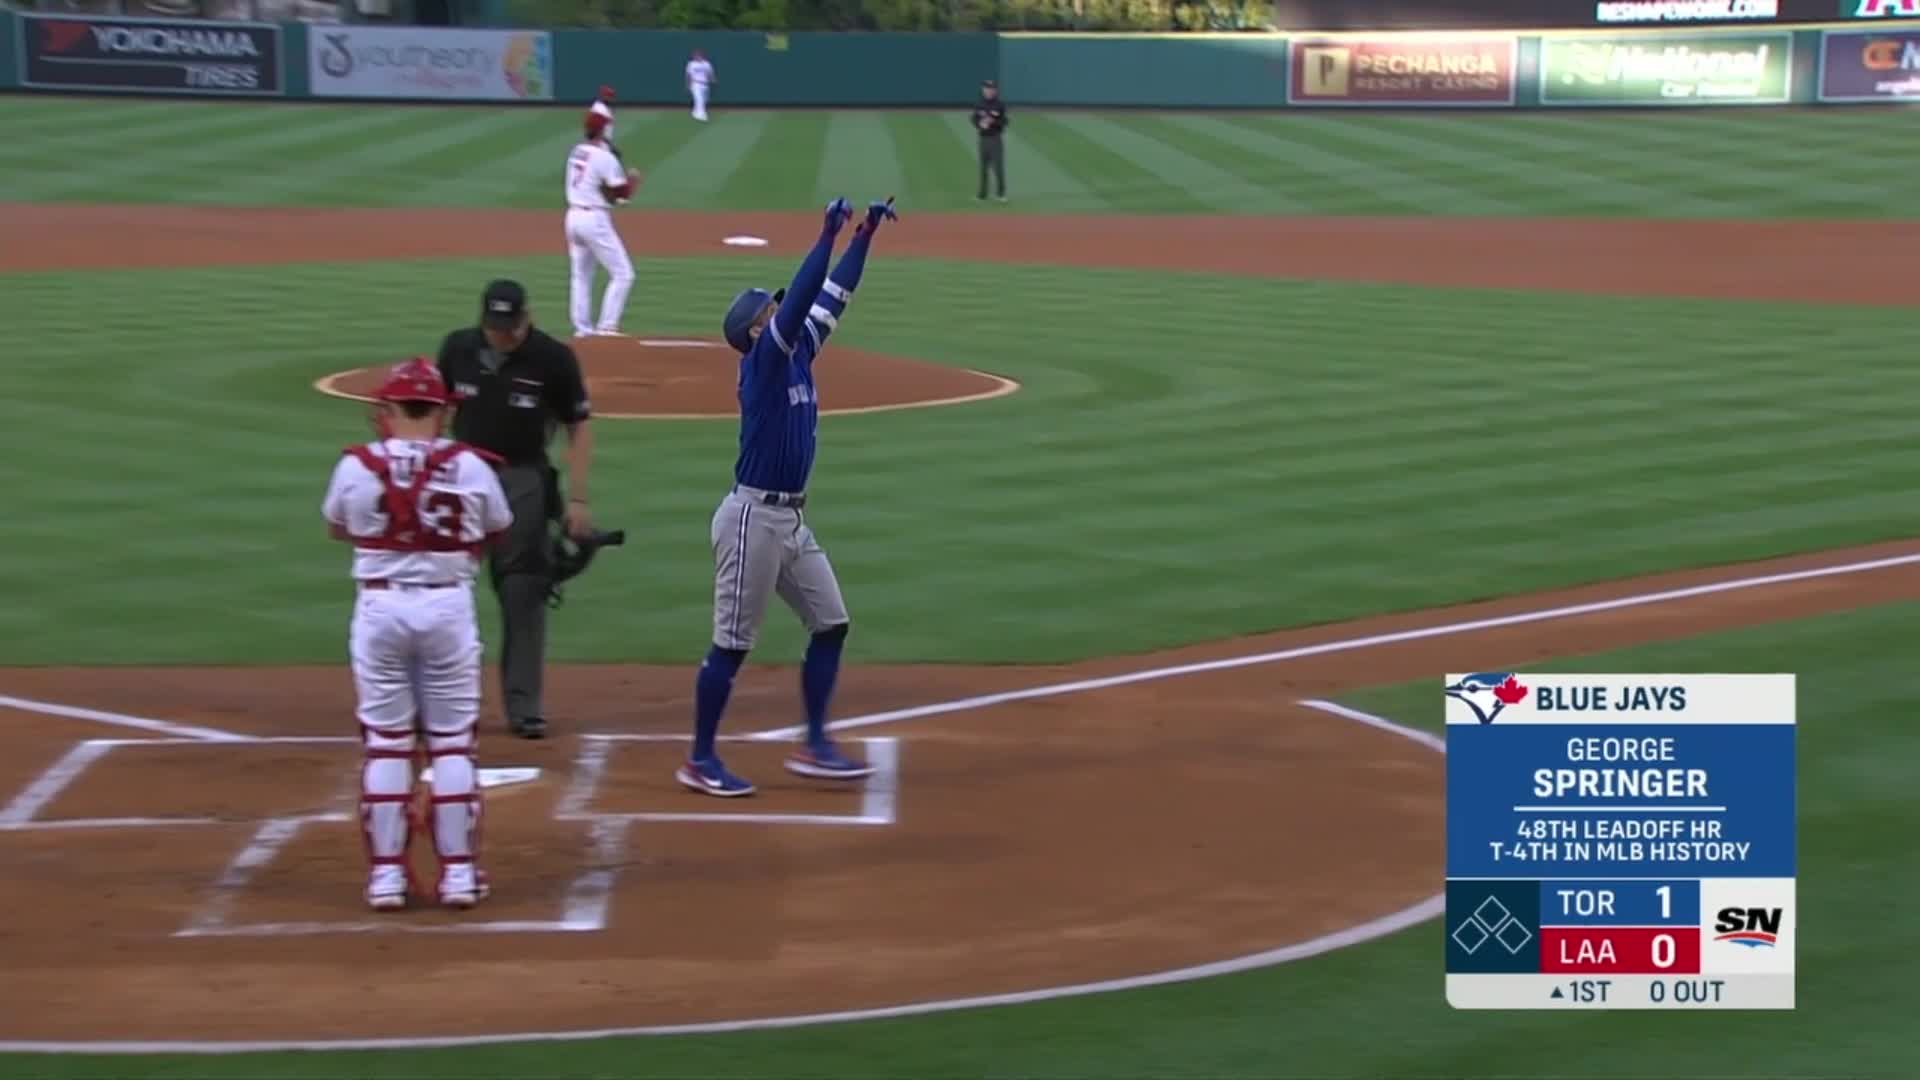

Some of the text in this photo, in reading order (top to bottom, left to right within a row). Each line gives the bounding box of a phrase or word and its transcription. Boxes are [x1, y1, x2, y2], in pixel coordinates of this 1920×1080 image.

[89, 25, 259, 57] YOKOHAMA
[183, 63, 259, 89] TIRES
[1356, 53, 1498, 75] PECHANGA
[1356, 75, 1499, 90] RESORT CASINO
